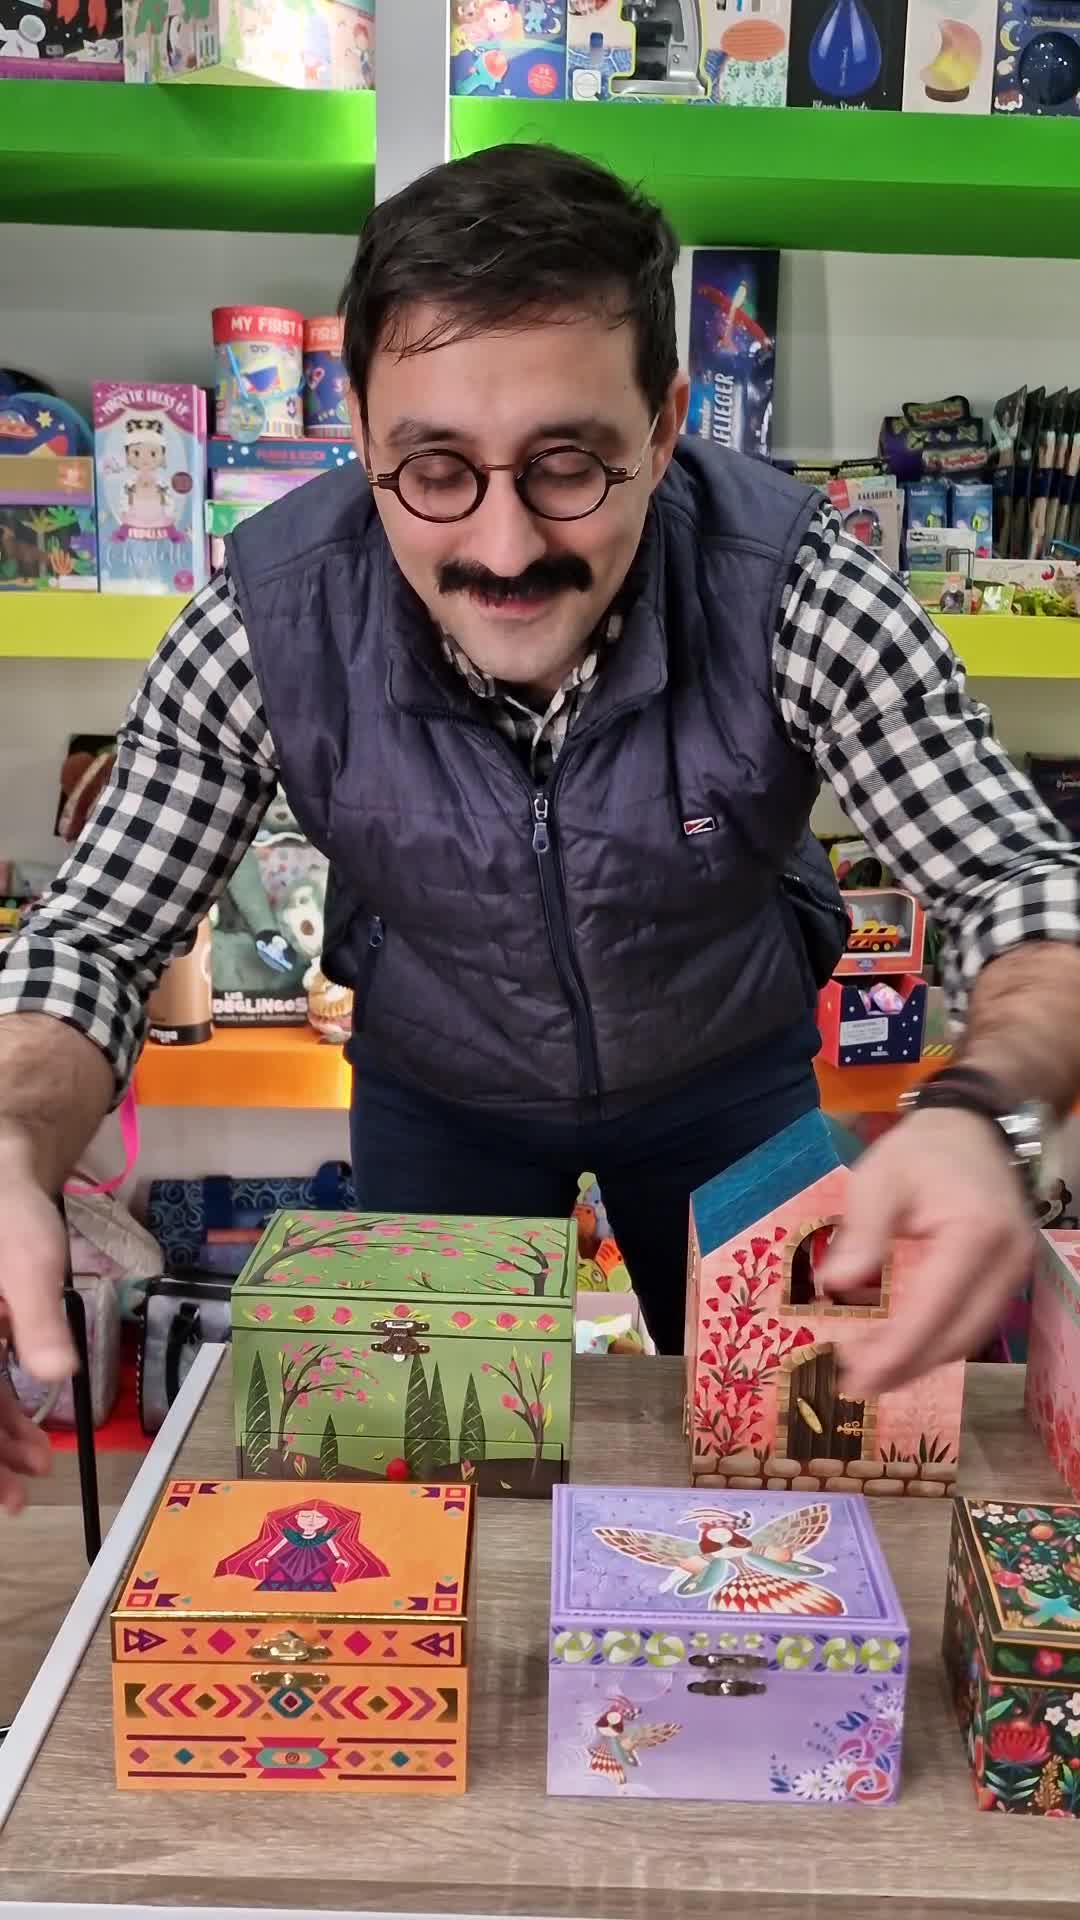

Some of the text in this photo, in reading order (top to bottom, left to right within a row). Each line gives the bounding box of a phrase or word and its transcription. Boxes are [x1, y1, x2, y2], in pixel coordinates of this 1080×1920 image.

[231, 315, 297, 337] MY FIRST
[310, 326, 343, 342] FIRS
